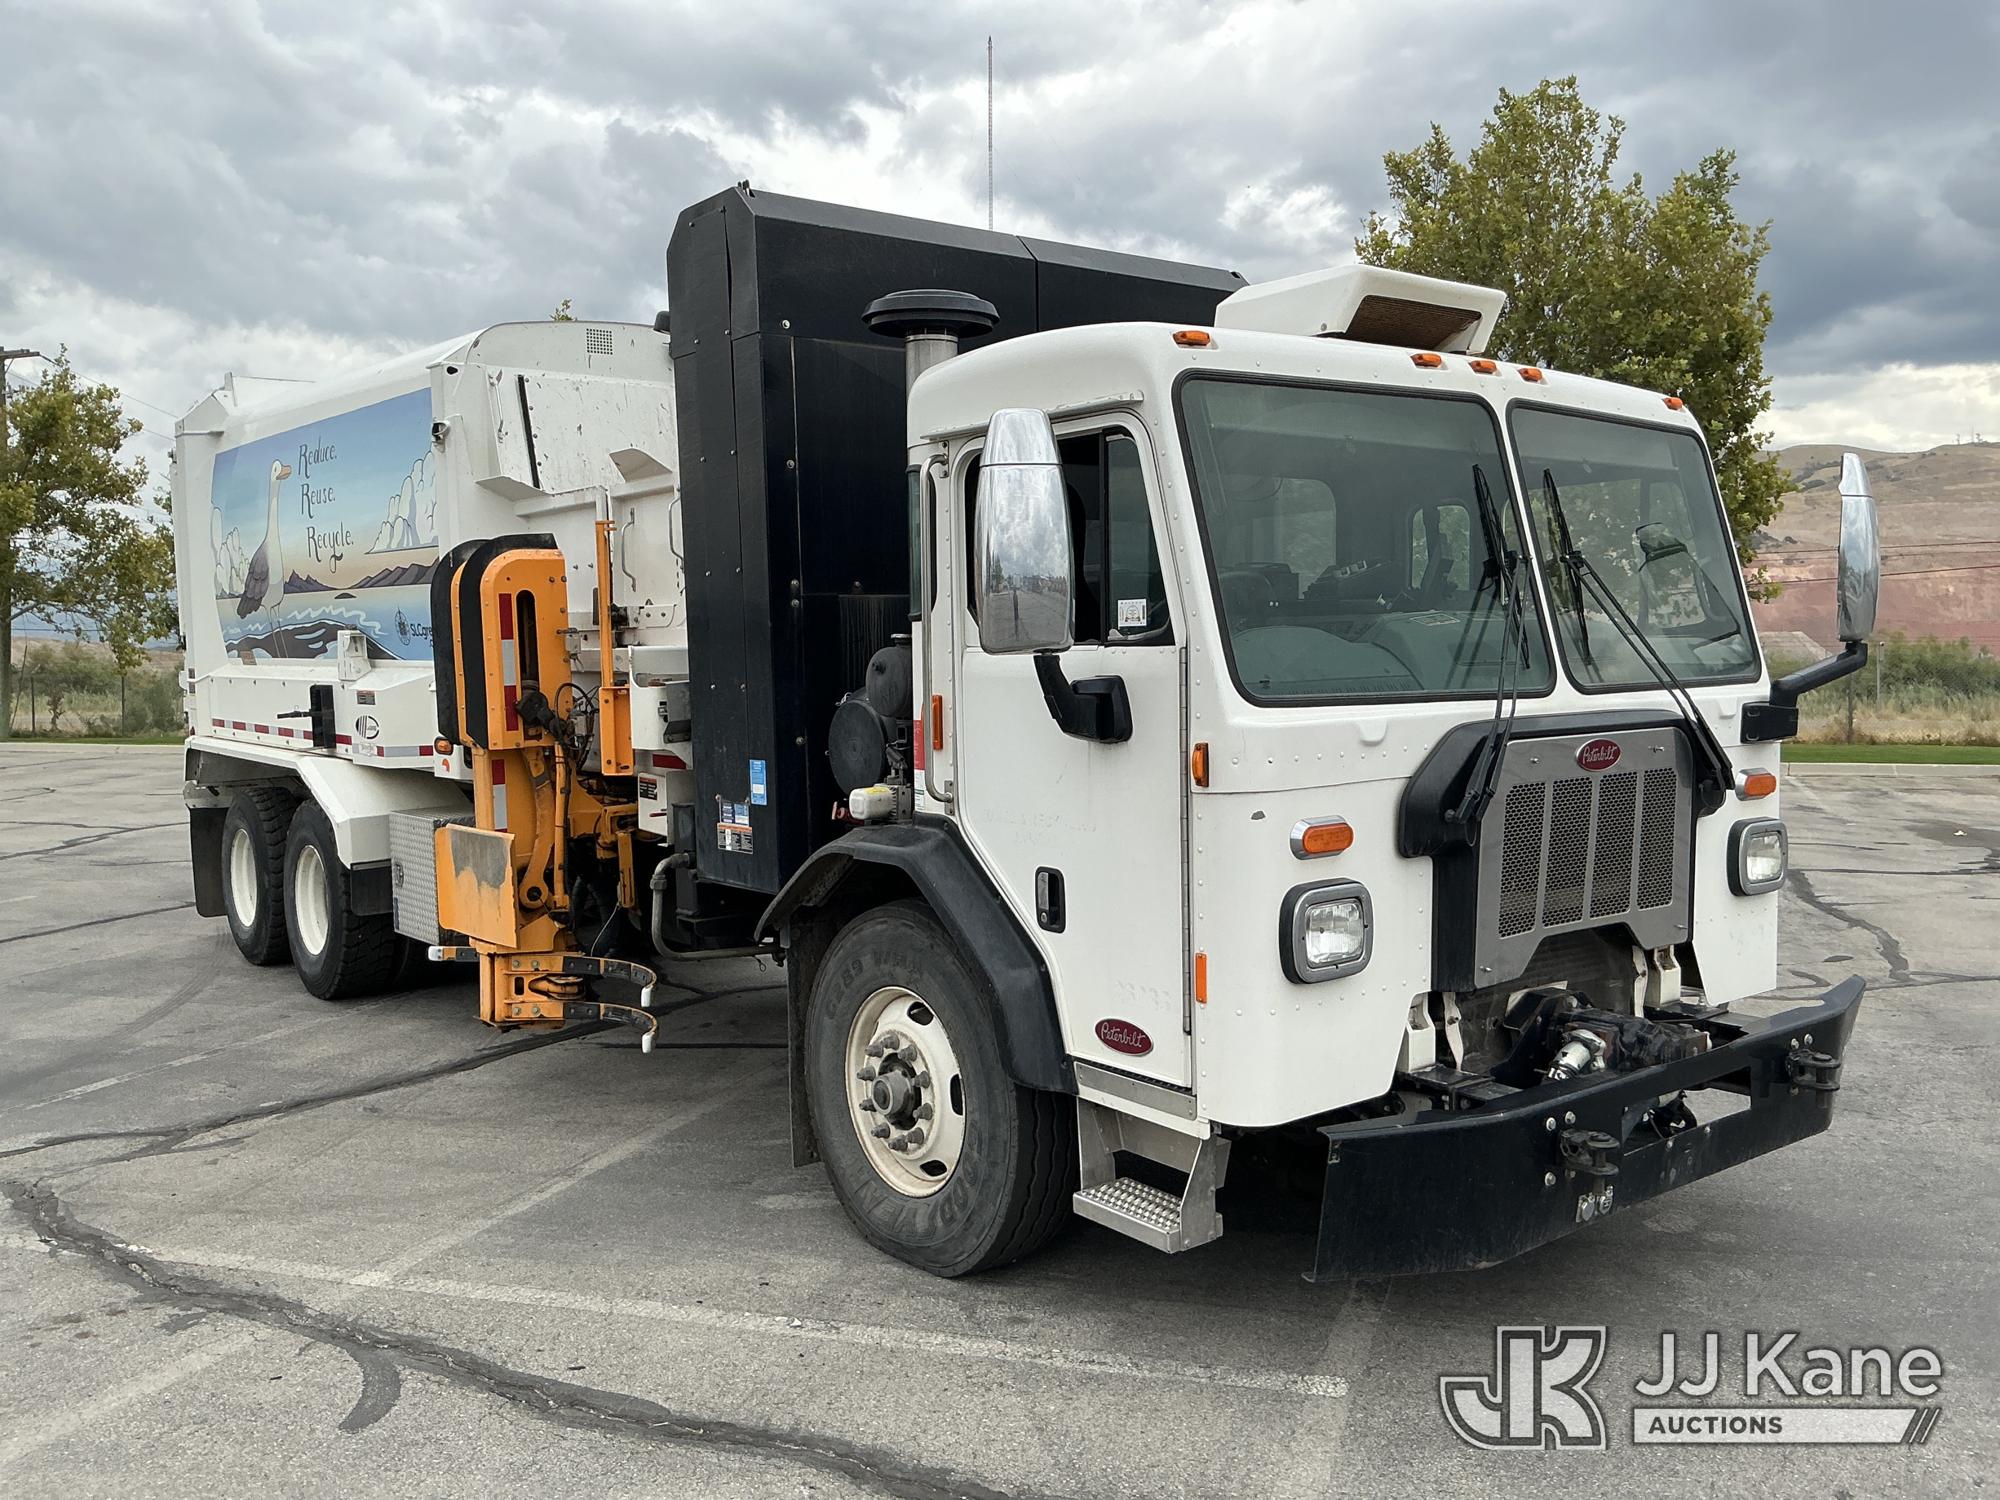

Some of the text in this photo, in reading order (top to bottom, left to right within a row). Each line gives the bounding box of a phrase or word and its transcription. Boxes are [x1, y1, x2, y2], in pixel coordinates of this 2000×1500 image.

[298, 436, 337, 479] Reduce.
[301, 483, 336, 519] Reuse.
[306, 521, 354, 574] Recycle.
[1582, 745, 1618, 764] Peterbilt
[1101, 1022, 1146, 1047] Peterbilt
